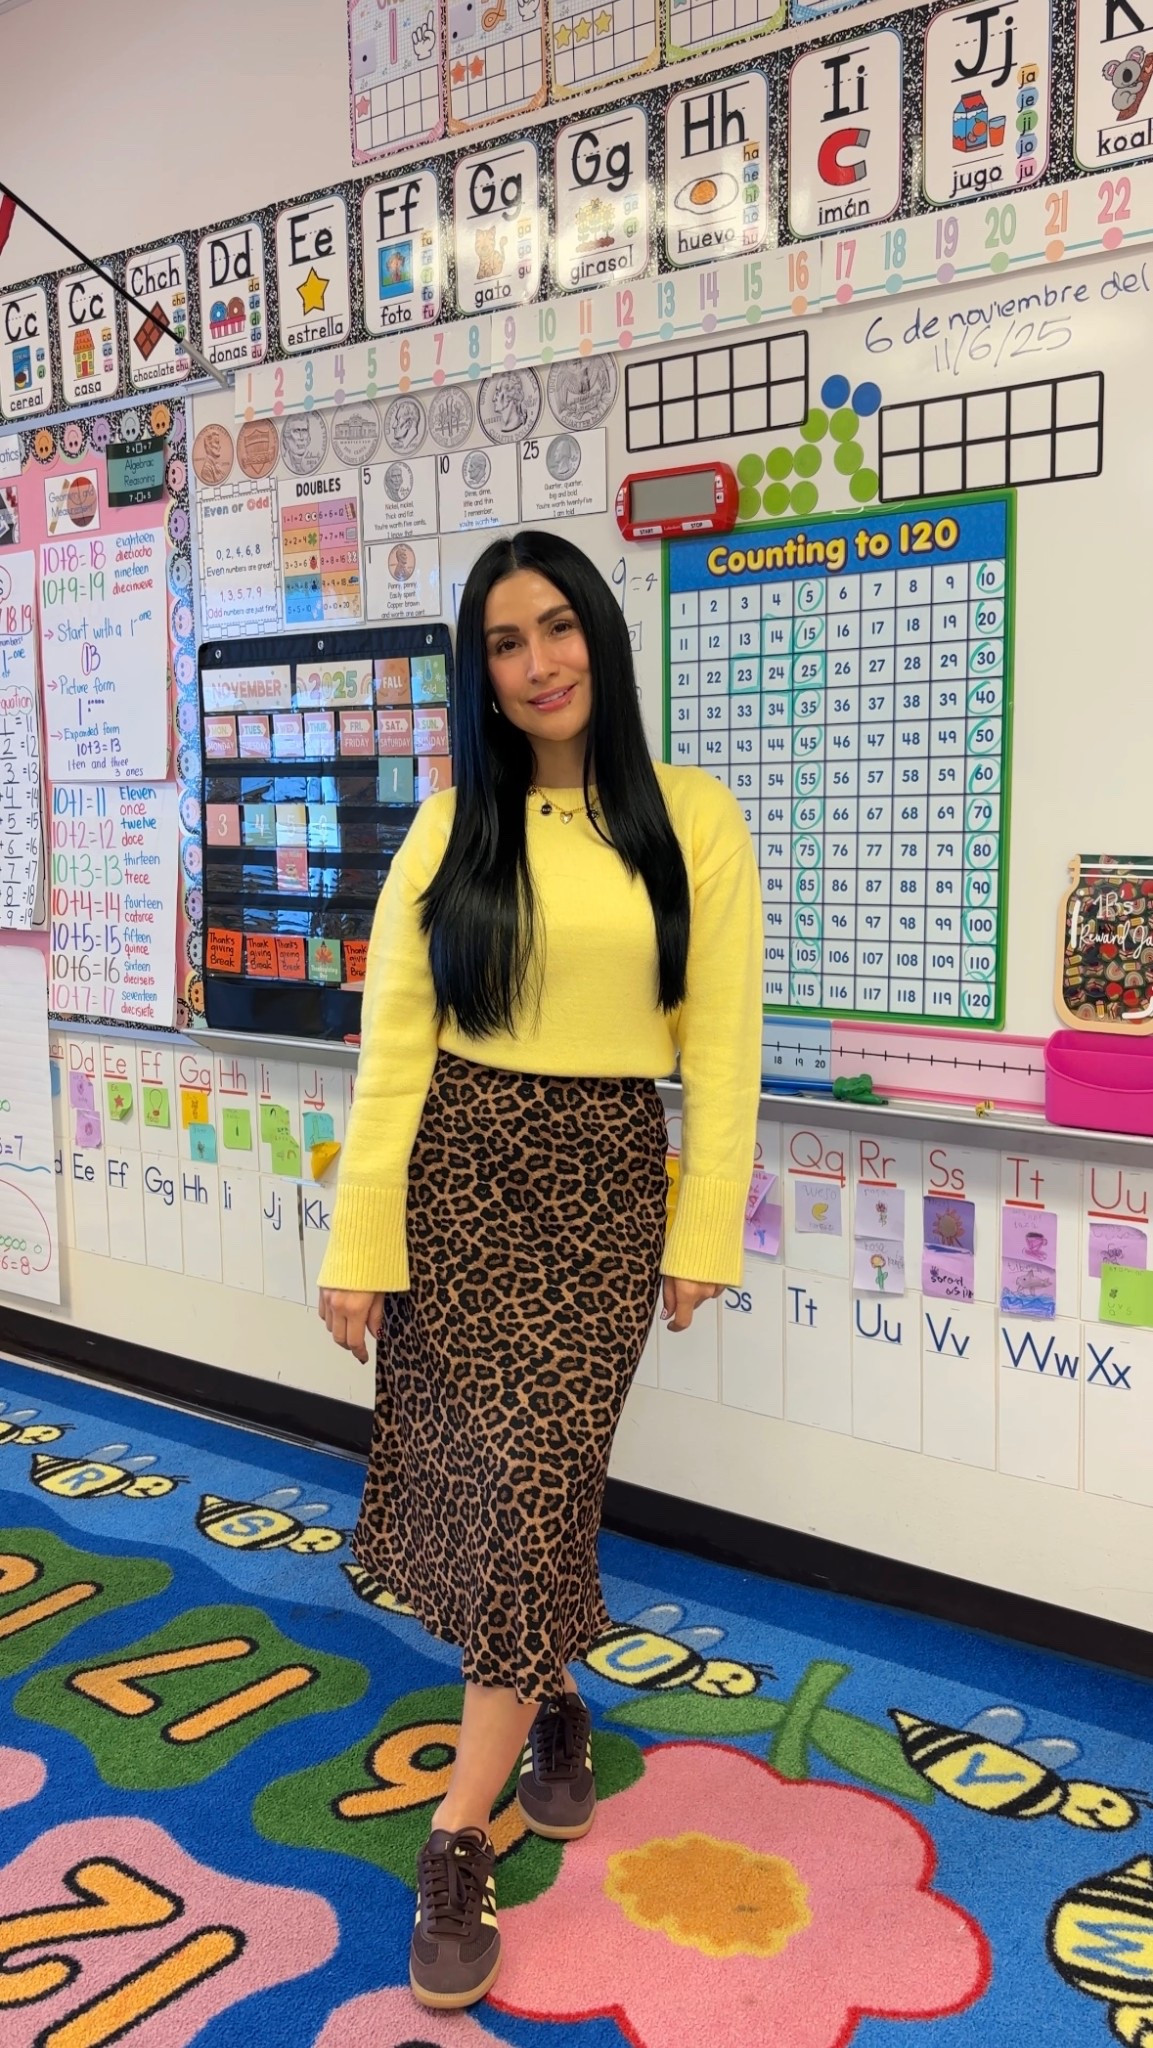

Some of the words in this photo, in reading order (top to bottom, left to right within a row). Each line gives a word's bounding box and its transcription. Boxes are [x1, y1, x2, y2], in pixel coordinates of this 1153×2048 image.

[955, 6, 1015, 88] Jj
[823, 54, 866, 119] Ii
[1018, 69, 1036, 89] ja
[1017, 93, 1035, 113] je
[683, 88, 745, 157] Hh
[1019, 116, 1031, 136] ji
[572, 132, 630, 192] Gg
[1017, 139, 1034, 159] jo
[951, 166, 1003, 198] jugo
[1016, 163, 1033, 183] ju
[469, 162, 523, 221] Gg
[378, 180, 421, 241] Ff
[817, 196, 871, 226] imán
[290, 213, 333, 265] Ee
[677, 226, 735, 254] huevo
[210, 230, 252, 286] Dd
[571, 243, 633, 285] girasol
[131, 257, 181, 297] Chch
[248, 373, 252, 402] 1
[275, 367, 284, 397] 2
[305, 361, 314, 391] 3
[334, 355, 345, 384] 4
[367, 347, 377, 378] 5
[400, 339, 410, 372] 6
[433, 333, 444, 365] 7
[468, 325, 479, 358] 8
[504, 316, 515, 350] 9
[538, 307, 556, 343] 10
[579, 299, 592, 335] 11
[616, 290, 634, 327] 12
[657, 281, 675, 319] 13
[699, 271, 719, 310] 14
[743, 262, 762, 301] 15
[788, 250, 809, 292] 16
[836, 239, 856, 281] 17
[884, 228, 907, 270] 18
[935, 216, 959, 260] 19
[984, 203, 1017, 249] 20
[1044, 189, 1069, 236] 21
[1096, 177, 1132, 225] 22
[68, 281, 105, 325] Cc
[474, 282, 511, 308] gato
[865, 316, 893, 354] 6
[903, 307, 939, 345] de
[948, 281, 1089, 329] noviembre
[1100, 260, 1151, 302] del
[5, 300, 39, 343] Cc
[381, 304, 411, 326] foto
[287, 316, 343, 346] estrella
[934, 315, 1071, 376] 11/6/25
[210, 345, 248, 364] donas
[74, 380, 102, 396] casa
[133, 365, 175, 383] chocolate
[10, 388, 43, 411] cereal
[439, 455, 450, 474] 10
[523, 440, 540, 461] 25
[295, 477, 341, 498] DOUBLES
[363, 468, 371, 485] 5
[203, 504, 229, 518] Even
[231, 502, 244, 514] or
[246, 496, 270, 511] Odd
[368, 546, 372, 564] 1
[706, 533, 848, 577] Counting
[854, 528, 892, 562] to
[898, 516, 961, 557] 120
[114, 564, 149, 580] nineteen
[682, 603, 686, 615] 1
[710, 600, 718, 612] 2
[741, 597, 748, 609] 3
[772, 593, 781, 605] 4
[805, 590, 814, 603] 5
[839, 586, 847, 600] 6
[873, 583, 882, 596] 7
[909, 580, 917, 593] 8
[945, 576, 954, 589] 9
[980, 572, 996, 585] 10
[57, 616, 89, 642] Start
[680, 638, 688, 650] 11
[708, 635, 720, 648] 12
[739, 633, 751, 646] 13
[771, 630, 783, 643] 14
[803, 627, 816, 640] 15
[836, 624, 849, 637] 16
[872, 621, 884, 635] 17
[906, 618, 920, 631] 18
[943, 615, 956, 629] 19
[977, 612, 996, 626] 20
[92, 678, 115, 694] form
[211, 678, 282, 699] NOVEMBER
[308, 670, 358, 700] 2025
[382, 675, 403, 689] FALL
[349, 722, 365, 732] FRI.
[384, 720, 404, 731] SAT.
[344, 738, 369, 749] FRIDAY
[381, 737, 411, 750] SATURDAY
[119, 784, 157, 801] Eleven
[392, 767, 398, 792] 1
[119, 802, 147, 816] once
[120, 816, 157, 830] twelve
[121, 830, 144, 846] doce
[218, 813, 228, 836] 3
[124, 851, 160, 866] thirteen
[124, 871, 151, 885] trece
[208, 931, 235, 946] Thanks
[210, 942, 234, 957] giving
[210, 954, 235, 968] Break
[766, 982, 782, 994] 114
[797, 984, 814, 996] 115
[830, 985, 847, 998] 116
[863, 987, 881, 1000] 117
[898, 989, 915, 1002] 118
[933, 991, 951, 1005] 119
[968, 993, 990, 1007] 120
[70, 1043, 95, 1073] Dd
[103, 1045, 126, 1075] Ee
[141, 1050, 162, 1079] Ff
[179, 1055, 211, 1096] Gg
[219, 1059, 246, 1090] Hh
[303, 1069, 324, 1110] Jj
[73, 1153, 95, 1182] Ee
[108, 1159, 129, 1188] Ff
[790, 1131, 846, 1189] Qq
[859, 1139, 897, 1180] Rr
[929, 1149, 965, 1190] Ss
[145, 1166, 174, 1206] Gg
[183, 1172, 208, 1203] Hh
[1006, 1157, 1044, 1200] Tt
[1091, 1167, 1146, 1215] Uu
[263, 1191, 282, 1231] Jj
[304, 1198, 331, 1230] Kk
[787, 1285, 818, 1326] Tt
[856, 1299, 901, 1344] Uu
[925, 1312, 970, 1358] Vv
[1001, 1326, 1079, 1379] Ww
[1086, 1342, 1132, 1389] Xx
